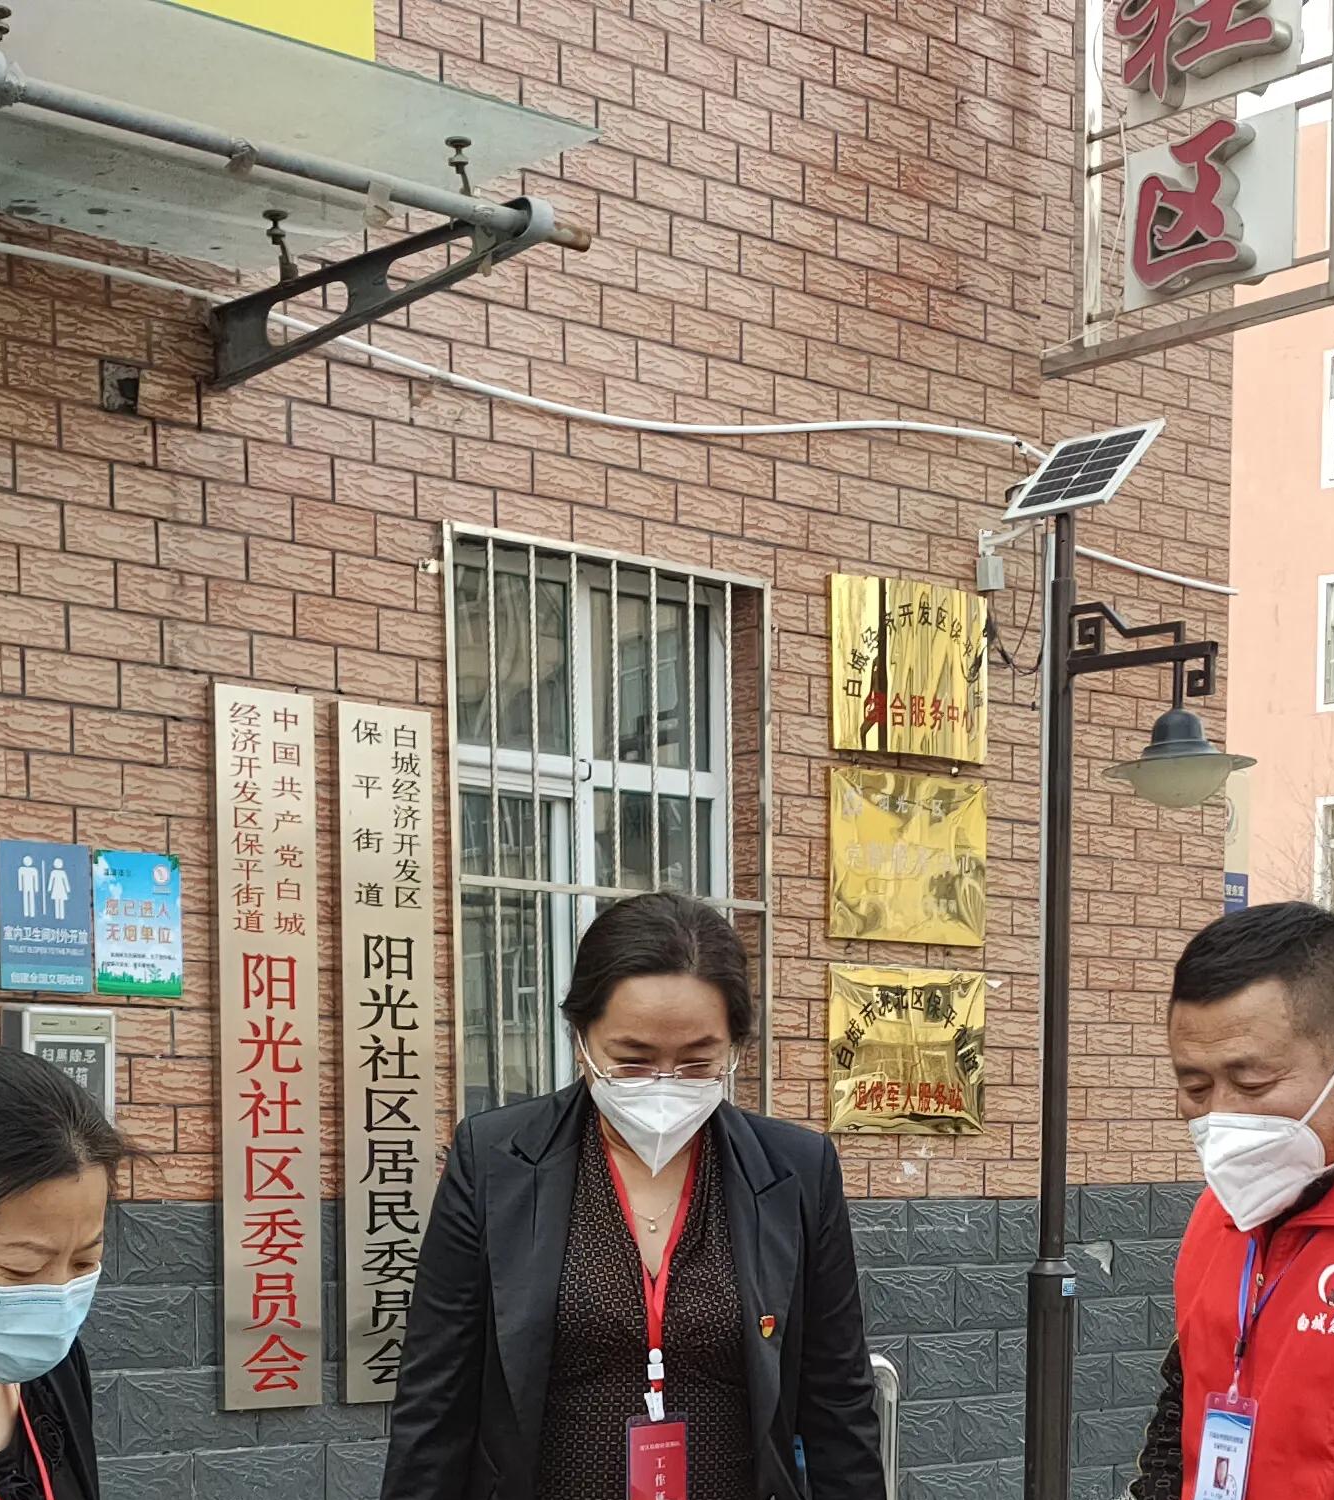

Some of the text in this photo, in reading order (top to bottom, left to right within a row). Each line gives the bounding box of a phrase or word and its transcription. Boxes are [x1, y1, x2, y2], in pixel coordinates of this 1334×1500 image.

[228, 702, 264, 933] 经济开发区保平街道
[272, 706, 306, 936] 中国共产党白城
[351, 718, 384, 907] 保平街道
[390, 724, 422, 909] 白城经济开发区
[237, 953, 308, 1393] 阳光社区委员会
[358, 934, 422, 1385] 阳光社区居民委员会
[853, 1080, 965, 1113] 退役军人服务站
